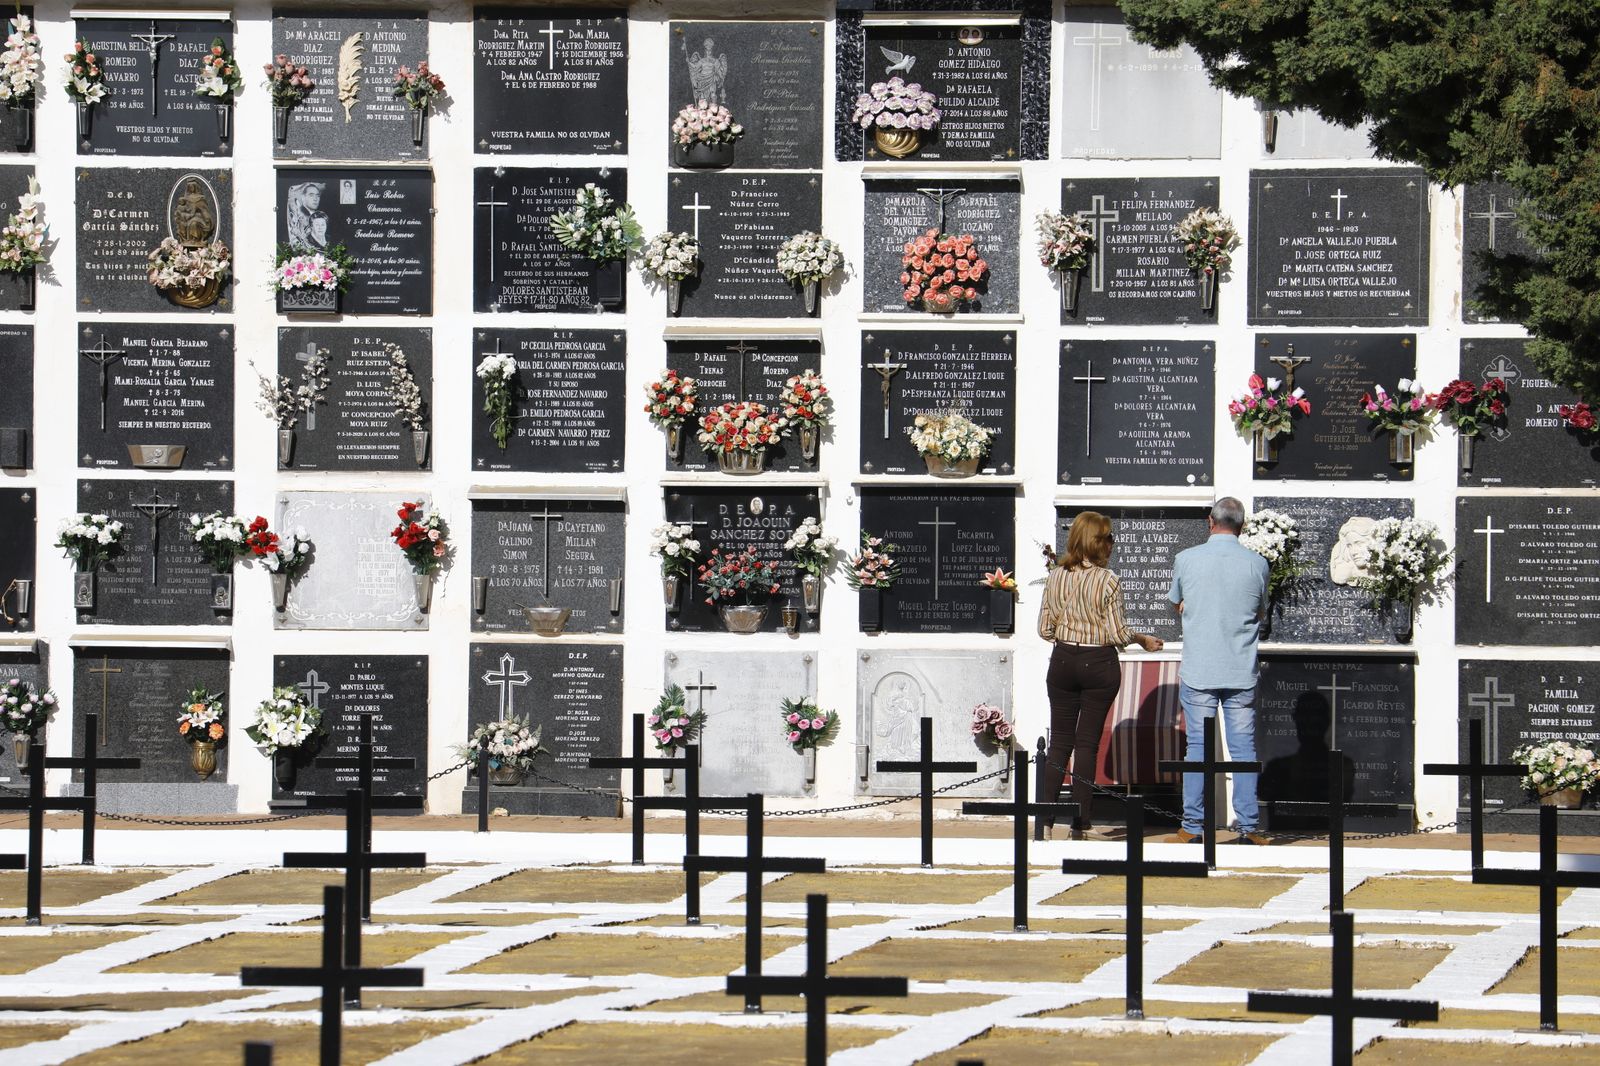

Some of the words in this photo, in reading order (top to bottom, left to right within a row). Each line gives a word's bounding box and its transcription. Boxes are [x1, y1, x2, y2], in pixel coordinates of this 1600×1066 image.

[308, 31, 341, 40] ARACELI
[373, 32, 406, 41] ANTONIO
[178, 43, 208, 52] RAFAEL
[304, 44, 323, 52] DIAZ
[372, 44, 401, 52] MEDINA
[478, 40, 514, 50] RODRIGUEZ
[517, 40, 544, 50] MARTIN
[556, 40, 582, 50] CASTRO
[585, 40, 621, 50] RODRIGUEZ
[570, 51, 606, 59] DICIEMBRE
[958, 48, 991, 56] ANTONIO
[106, 57, 137, 66] ROMERO
[179, 58, 198, 68] DIAZ
[375, 56, 397, 64] LEIVA
[939, 60, 965, 68] GOMEZ
[968, 60, 1000, 68] HIDALGO
[958, 85, 992, 94] RAFAELA
[939, 98, 965, 106] PULIDO
[968, 98, 1000, 106] ALCAIDE
[1122, 200, 1148, 209] FELIPA
[1150, 200, 1194, 209] FERNANDEZ
[901, 206, 926, 216] VALLE
[958, 209, 1000, 218] RODRIGUEZ
[1136, 212, 1172, 221] MELLADO
[884, 217, 928, 226] DOMINGUEZ
[963, 214, 993, 231] LOZANO
[1140, 235, 1168, 243] PUEBLA
[1292, 237, 1323, 246] ANGELA
[1326, 237, 1362, 246] VALLEJO
[1366, 236, 1397, 245] PUEBLA
[1304, 251, 1325, 259] JOSE
[1328, 250, 1360, 259] ORTEGA
[1363, 250, 1381, 259] RUIZ
[1138, 257, 1169, 265] ROSARIO
[1116, 269, 1145, 277] MILLAN
[1150, 268, 1190, 277] MARTINEZ
[1296, 264, 1323, 272] MARITA
[1357, 264, 1392, 272] SANCHEZ
[1303, 277, 1326, 286] LUISA
[503, 286, 535, 295] DOLORES
[536, 286, 588, 295] SANTISTEBAN
[498, 295, 522, 304] REYES
[123, 337, 147, 346] MANUEL
[151, 338, 173, 347] GARCIA
[177, 338, 208, 347] BEJARANO
[529, 341, 553, 350] CECILIA
[554, 342, 582, 350] PEDROSA
[583, 342, 606, 351] GARCIA
[704, 353, 726, 361] RAFAEL
[942, 352, 979, 360] GONZALEZ
[981, 352, 1012, 360] HERRERA
[1177, 356, 1198, 365] NUÑEZ
[122, 357, 148, 366] VICENTA
[152, 357, 175, 367] MERINA
[179, 358, 210, 367] GONZALEZ
[700, 366, 723, 374] TRENAS
[763, 366, 788, 375] MORENO
[983, 371, 1004, 380] LUQUE
[114, 376, 161, 385] MAMI-ROSALIA
[190, 377, 214, 386] YANASE
[766, 379, 782, 388] DIAZ
[542, 390, 578, 398] FERNANDEZ
[580, 390, 608, 398] NAVARRO
[976, 390, 1006, 398] GUZMAN
[530, 409, 552, 417] EMILIO
[558, 429, 587, 437] NAVARRO
[591, 429, 610, 438] PEREZ
[737, 517, 790, 528] JOAQUIN
[1132, 521, 1165, 530] DOLORES
[711, 530, 764, 540] SANCHEZ
[884, 530, 913, 538] ANTONIO
[958, 530, 994, 539] ENCARNITA
[1142, 534, 1178, 543] ALVAREZ
[499, 536, 532, 546] GALINDO
[566, 536, 596, 547] MILLAN
[952, 543, 972, 552] LOPEZ
[976, 543, 1000, 552] ICARDO
[503, 549, 527, 560] SIMON
[566, 550, 594, 560] SEGURA
[898, 601, 923, 610] MIGUEL
[1276, 681, 1307, 691] MIGUEL
[1352, 682, 1399, 692] FRANCISCA
[1545, 690, 1578, 698] FAMILIA
[1344, 700, 1374, 710] ICARDO
[1377, 700, 1405, 710] REYES
[1528, 704, 1559, 712] PACHON
[1566, 704, 1595, 713] GOMEZ
